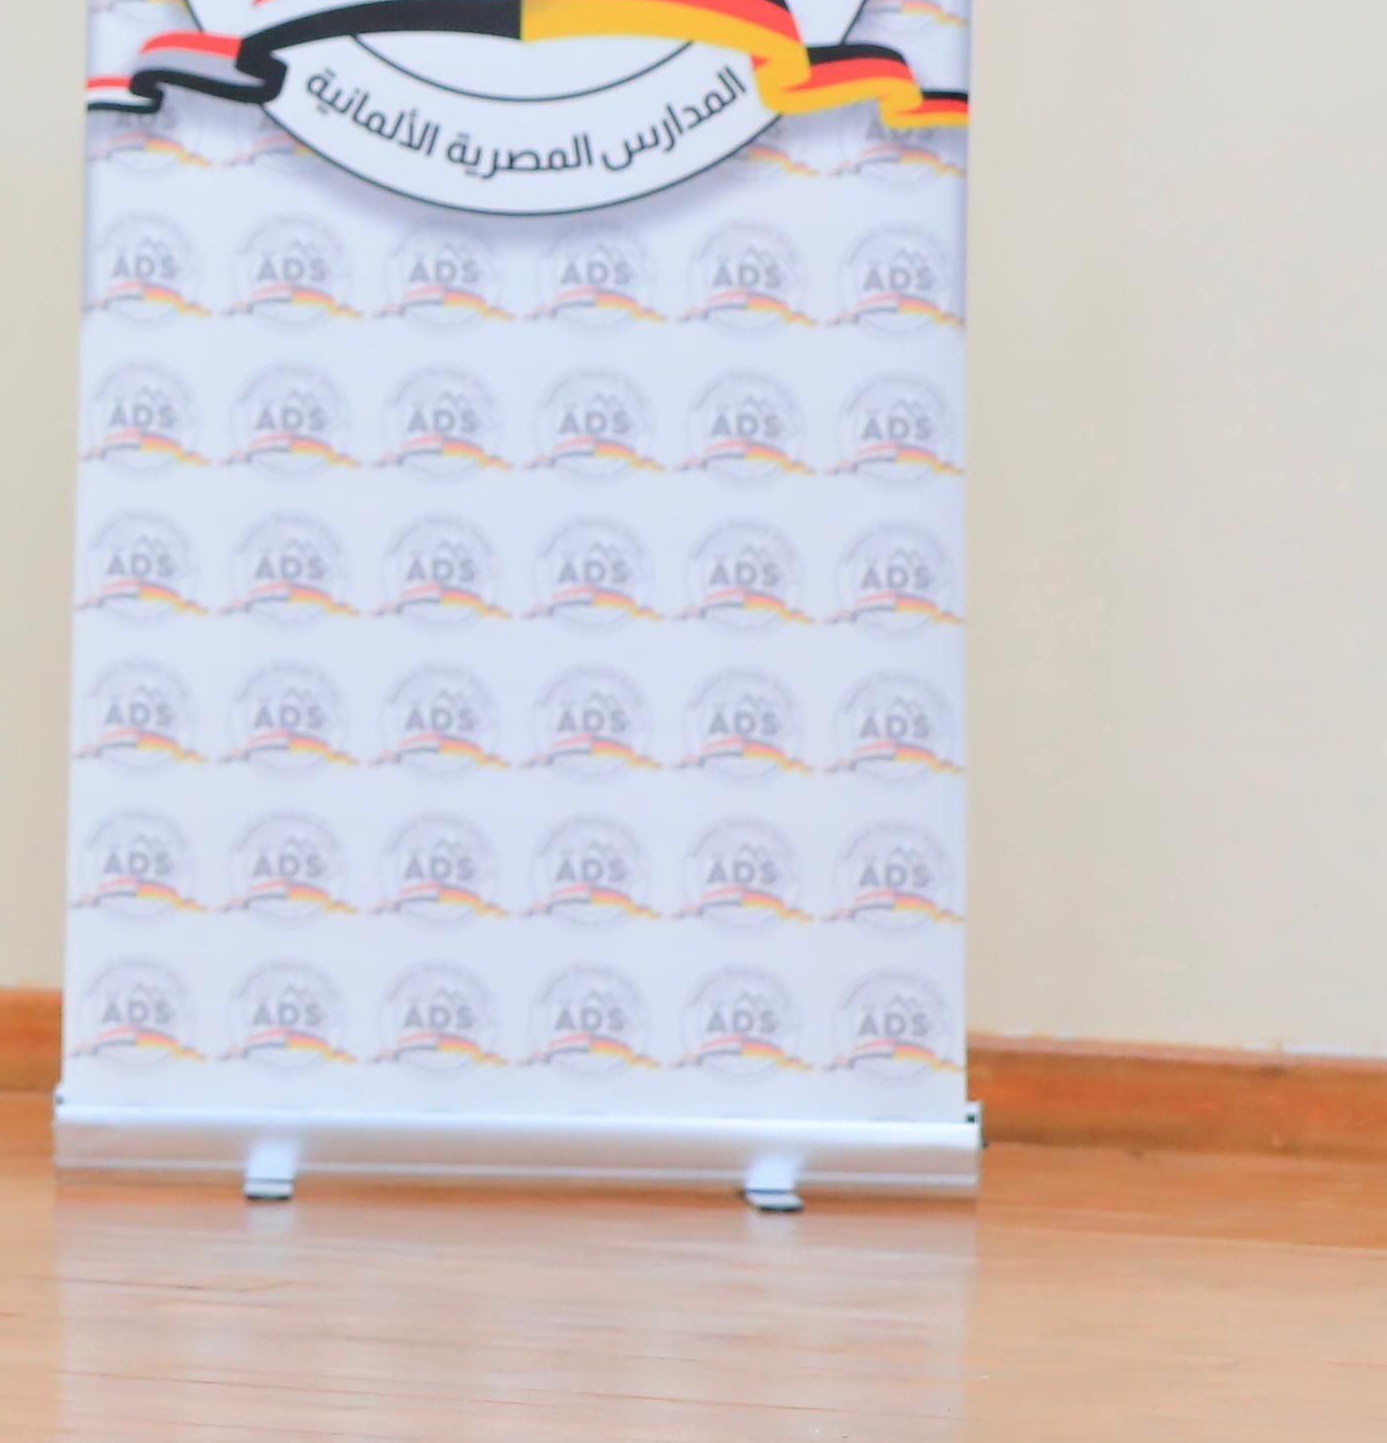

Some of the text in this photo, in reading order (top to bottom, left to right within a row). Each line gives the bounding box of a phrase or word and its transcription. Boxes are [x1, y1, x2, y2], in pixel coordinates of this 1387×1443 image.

[304, 65, 748, 180] المدارس المصرية الألمانية
